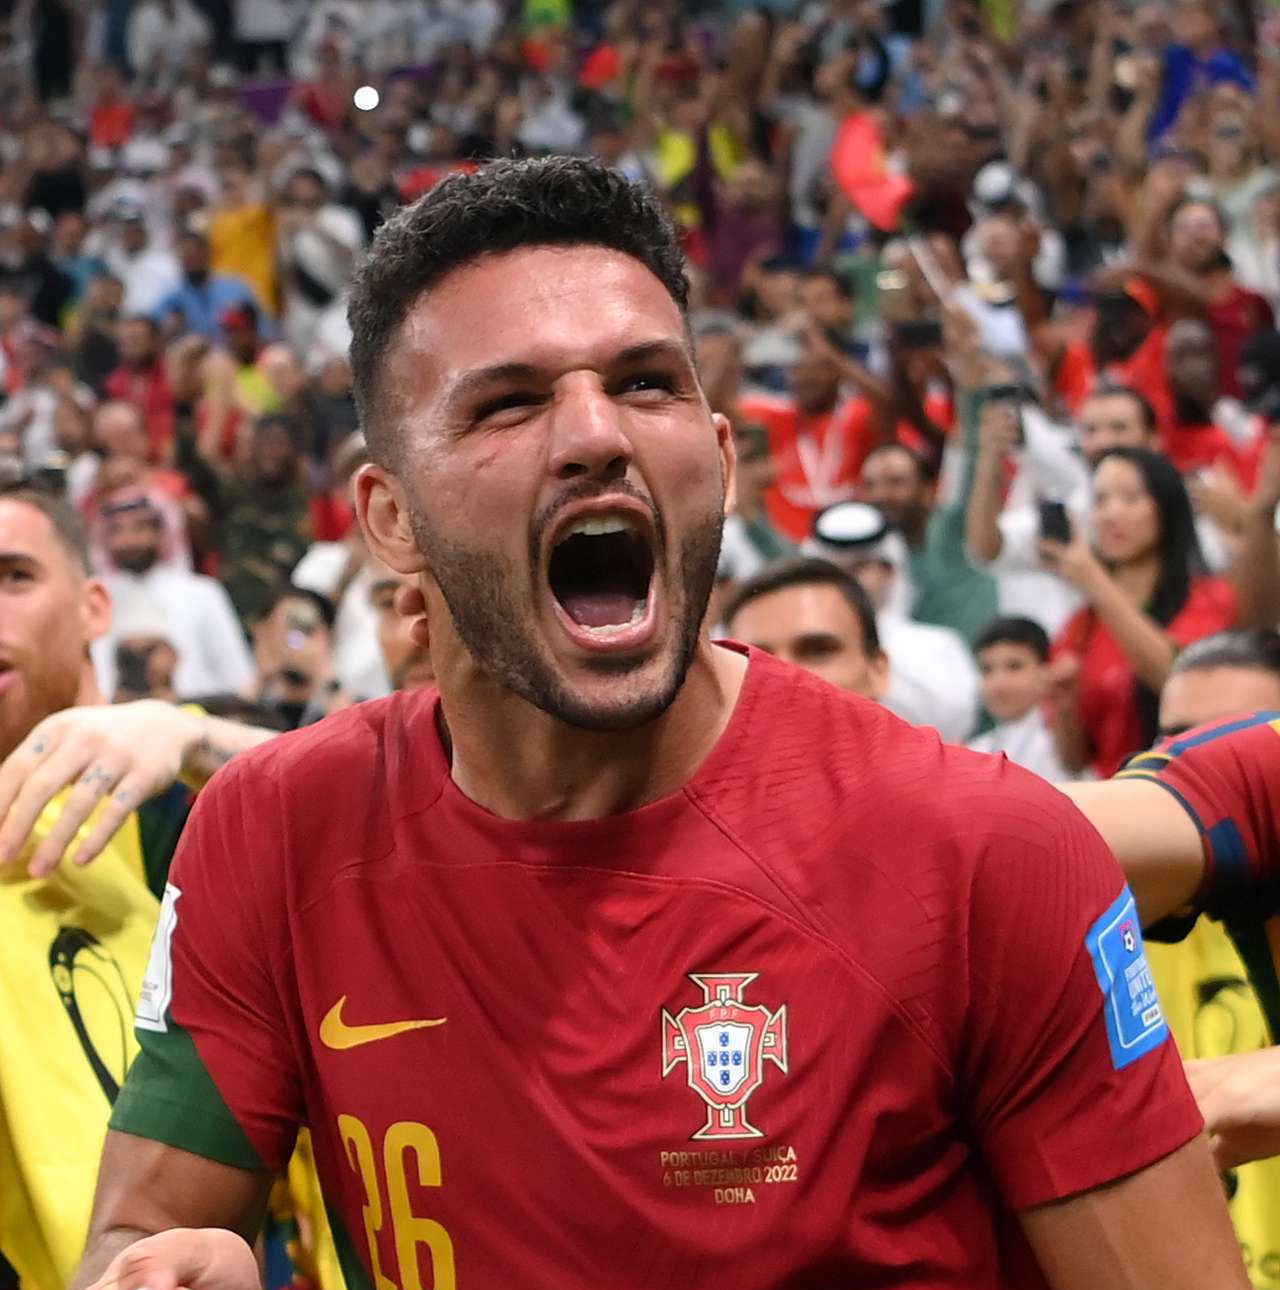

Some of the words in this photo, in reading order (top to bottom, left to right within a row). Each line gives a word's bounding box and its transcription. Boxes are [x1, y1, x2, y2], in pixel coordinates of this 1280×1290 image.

[674, 1171, 691, 1187] DE
[764, 1164, 798, 1183] 2022
[715, 1188, 756, 1204] DOHA
